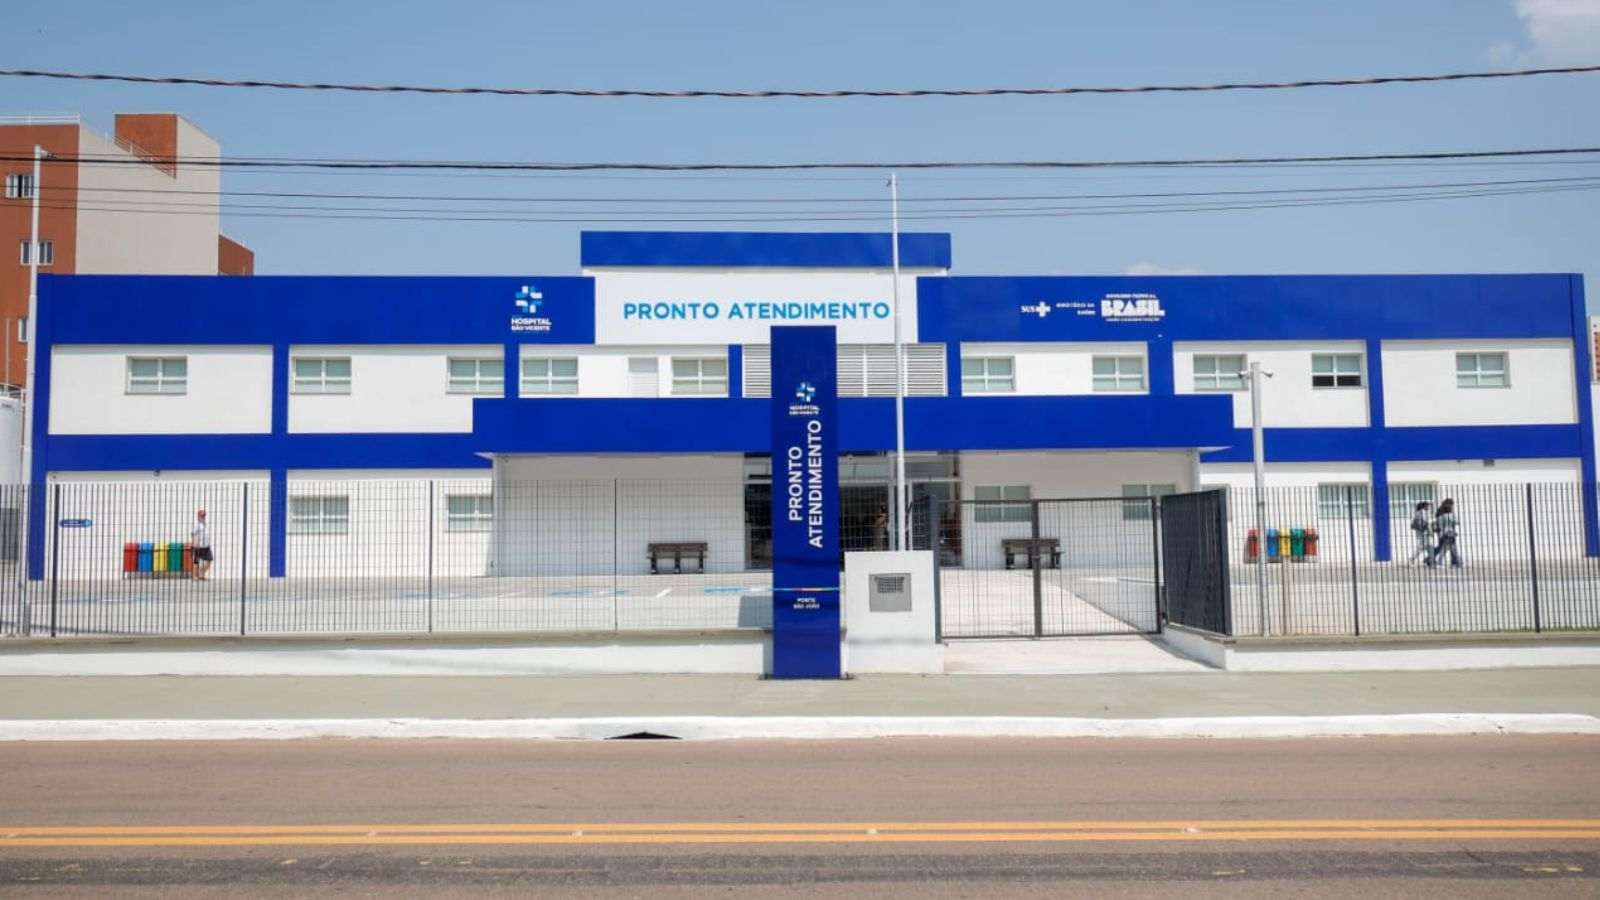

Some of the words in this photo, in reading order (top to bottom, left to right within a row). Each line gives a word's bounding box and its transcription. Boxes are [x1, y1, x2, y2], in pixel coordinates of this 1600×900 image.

[624, 302, 720, 319] PRONTO
[728, 302, 890, 319] ATENDIMENTO
[1101, 299, 1165, 317] BRASIL
[788, 446, 803, 521] PRONTO
[807, 420, 823, 548] ATENDIMENTO
